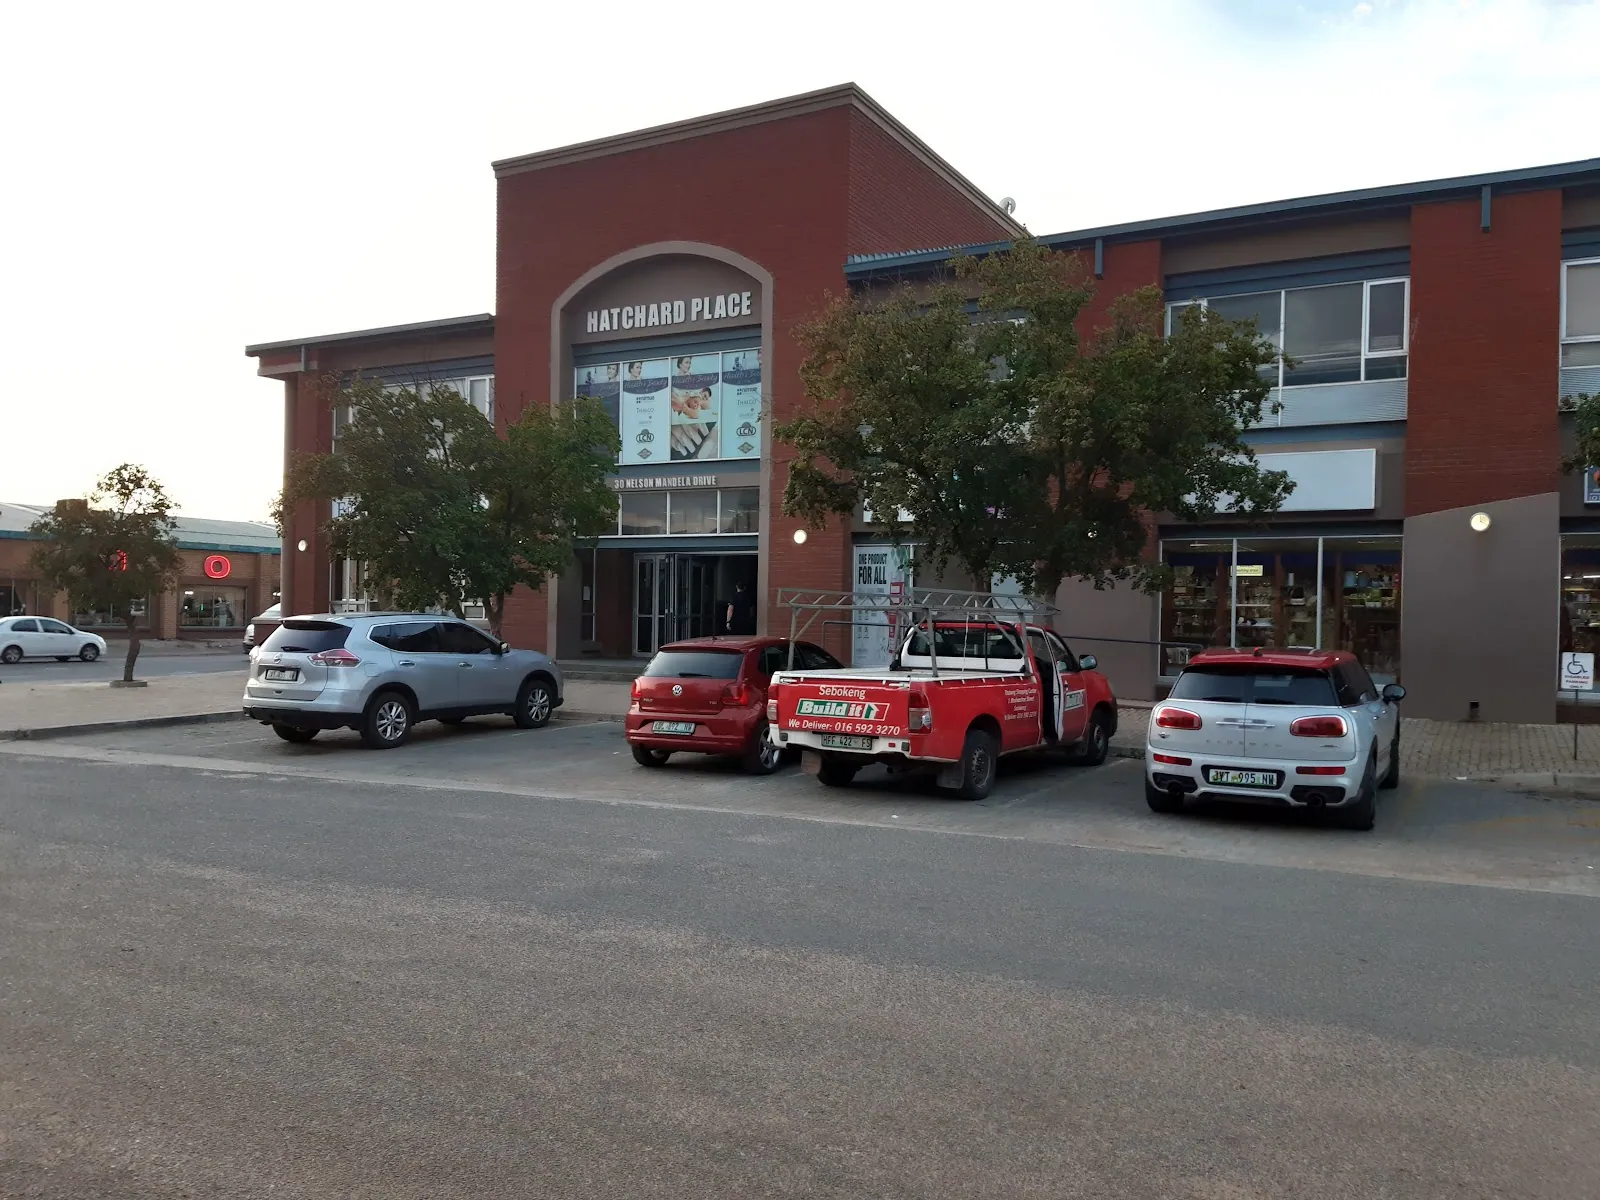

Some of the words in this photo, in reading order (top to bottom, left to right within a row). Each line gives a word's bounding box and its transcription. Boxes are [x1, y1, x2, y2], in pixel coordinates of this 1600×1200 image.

[586, 300, 685, 333] HATCHARD
[691, 291, 751, 322] PLACE
[638, 434, 652, 442] LCN
[739, 427, 753, 435] LCN
[614, 479, 625, 489] 30
[625, 478, 654, 489] NELSON
[655, 476, 691, 488] MANDELA
[692, 475, 717, 486] DRIVE
[858, 553, 868, 565] ONE
[868, 553, 888, 565] PRODUCT
[858, 566, 873, 585] FOR
[873, 566, 887, 585] ALL
[818, 685, 866, 700] Sebokeng
[800, 701, 847, 716] Build
[848, 703, 862, 717] it
[788, 719, 800, 728] We
[802, 720, 832, 731] Deliver:
[835, 722, 853, 732] 016
[855, 723, 873, 734] 592
[874, 725, 900, 736] 3270
[839, 736, 852, 746] 422
[861, 737, 871, 748] FS
[1238, 772, 1256, 784] 995
[1262, 773, 1274, 785] NW
